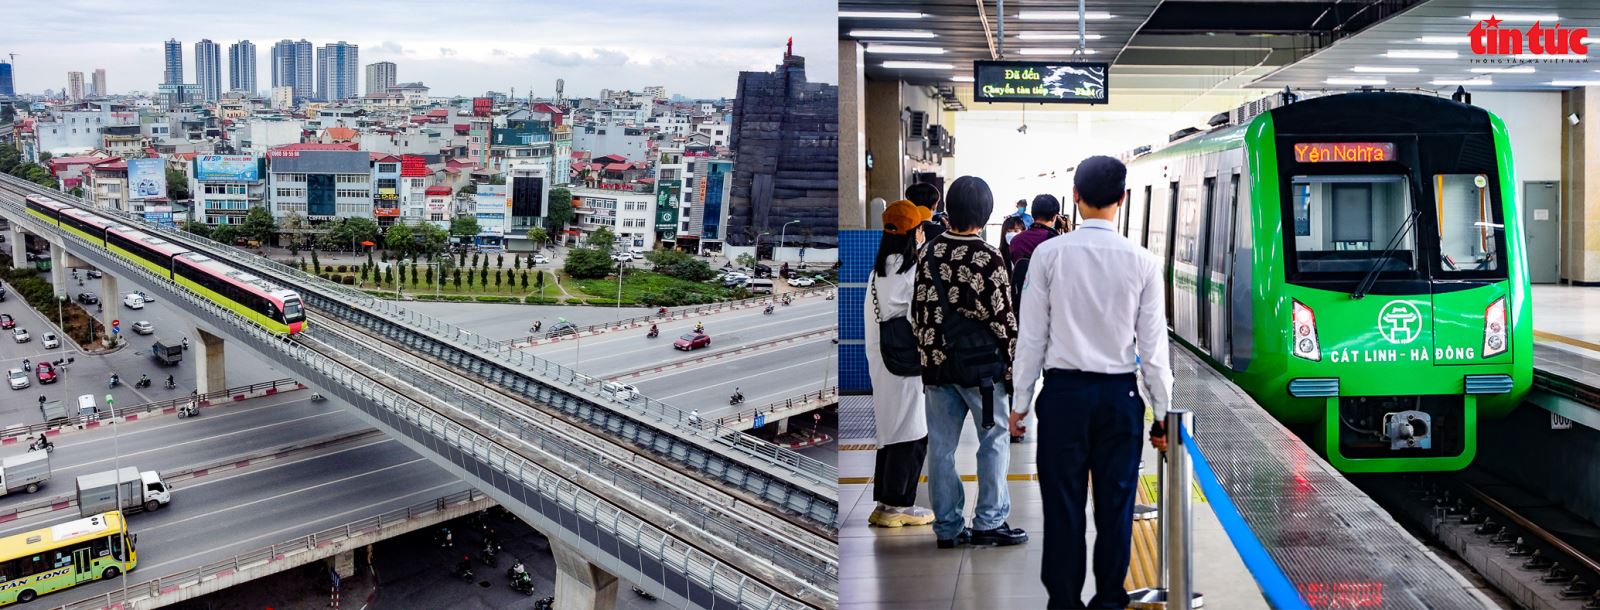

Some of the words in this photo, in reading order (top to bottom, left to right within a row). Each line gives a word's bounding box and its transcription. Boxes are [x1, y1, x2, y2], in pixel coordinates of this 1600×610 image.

[1004, 69, 1020, 80] Đã
[1022, 67, 1040, 80] đến
[1294, 145, 1330, 162] Yên
[1331, 347, 1359, 362] CÁT
[1364, 350, 1397, 362] LINH
[1410, 346, 1429, 360] HÀ
[1435, 345, 1475, 360] ĐÔNG
[36, 568, 70, 581] LONG
